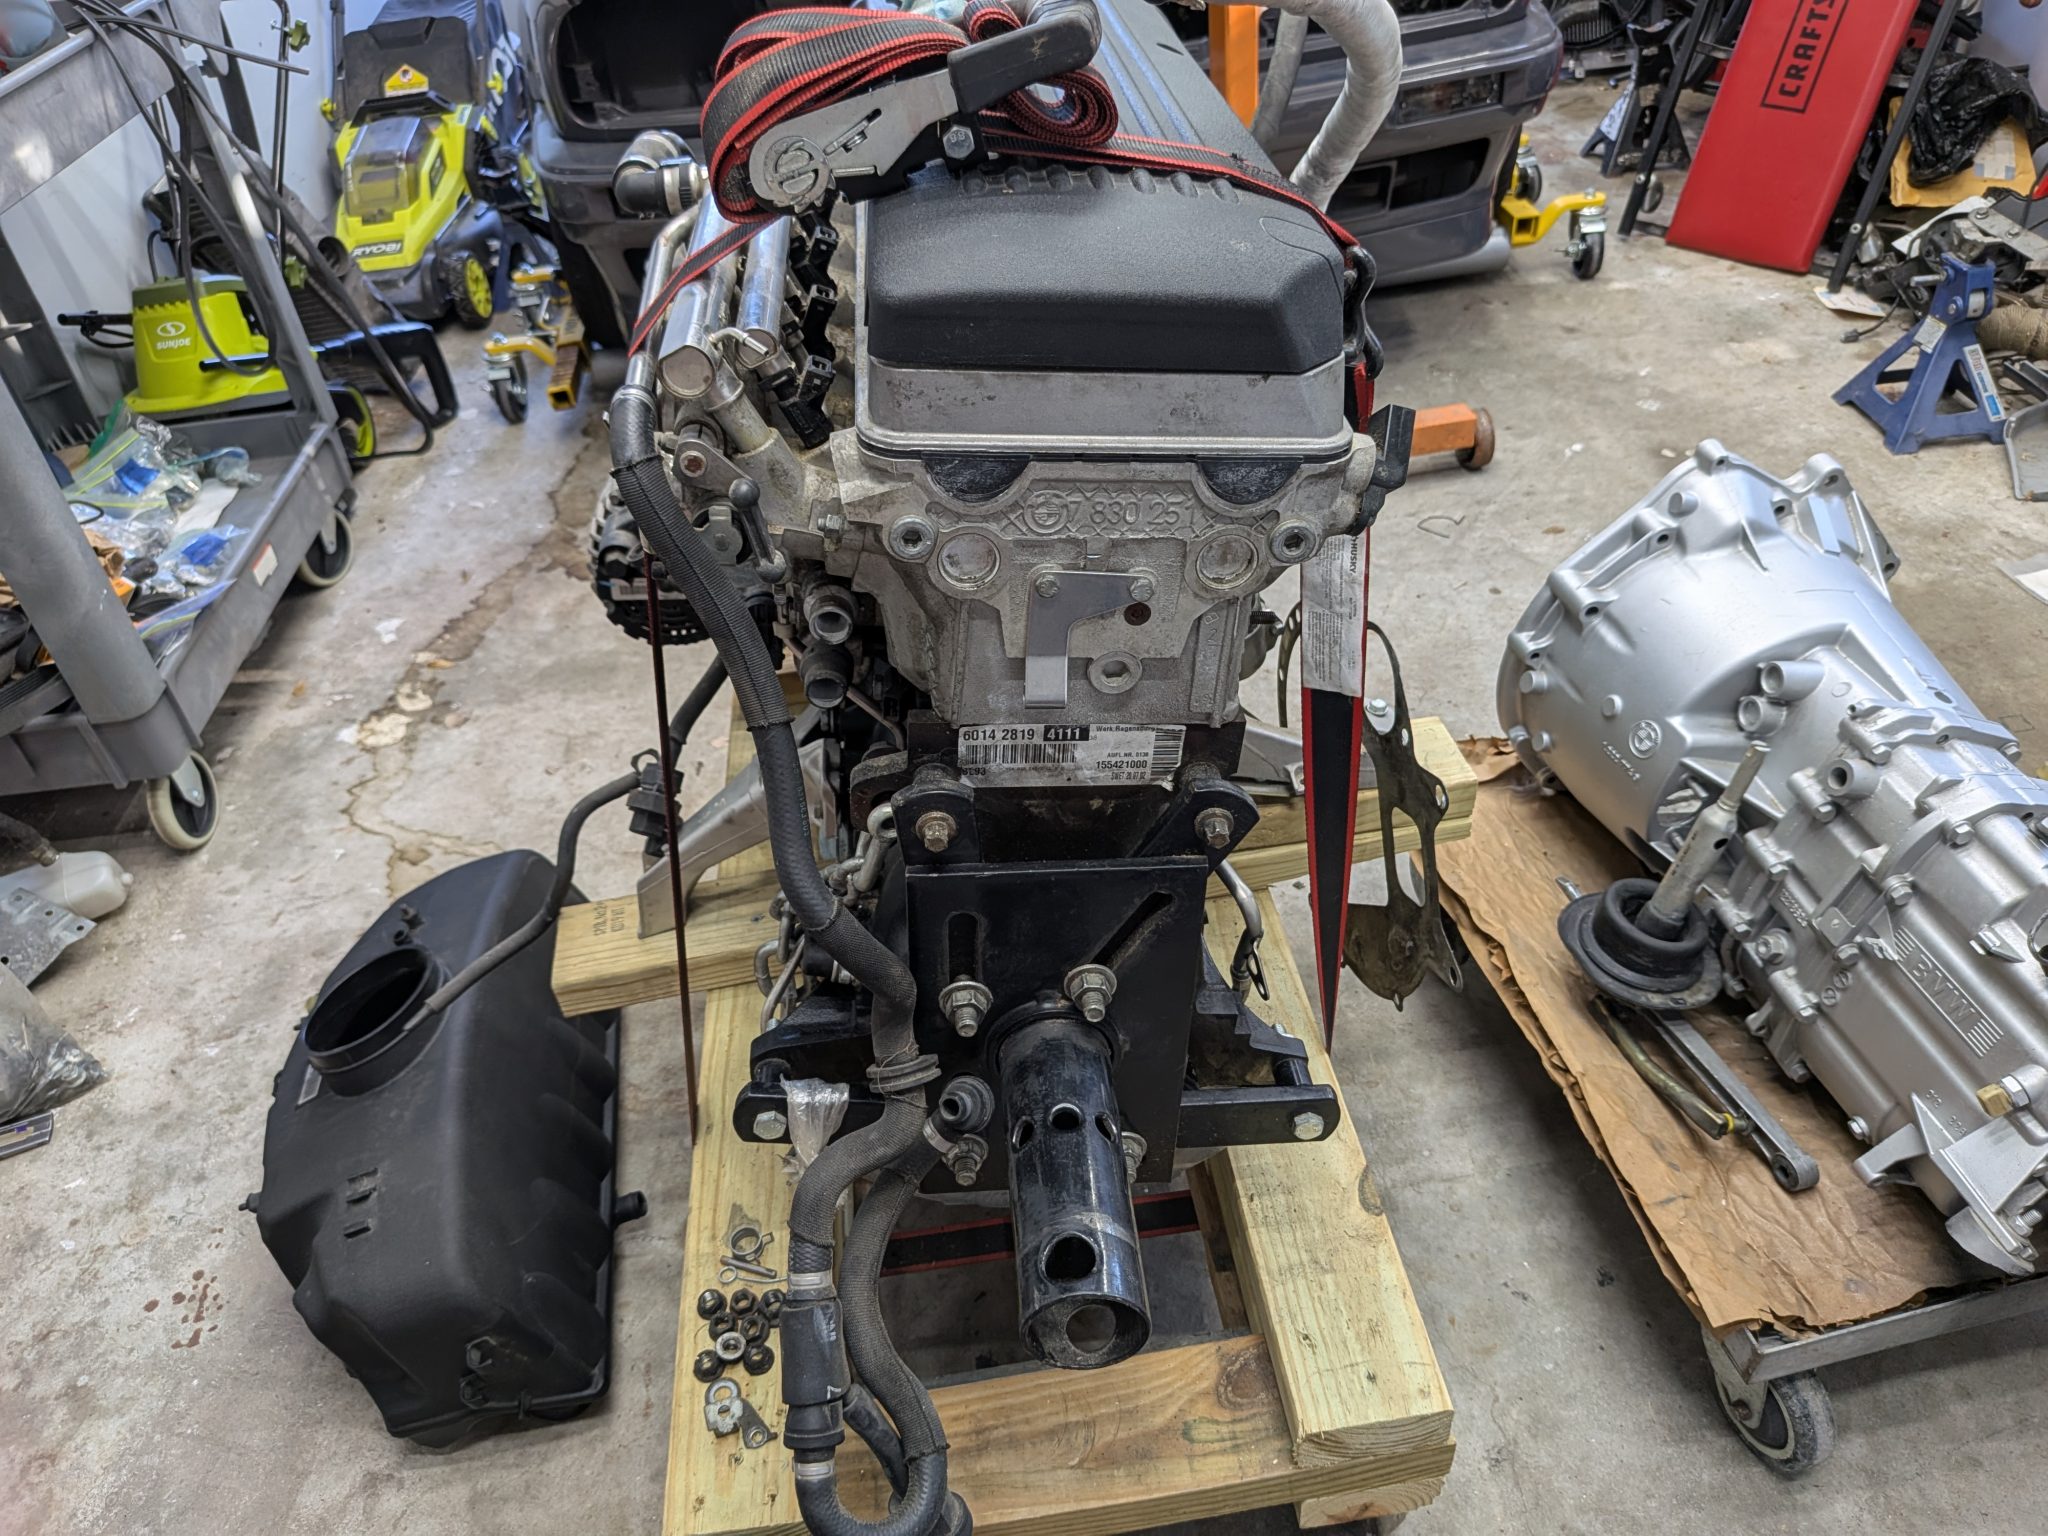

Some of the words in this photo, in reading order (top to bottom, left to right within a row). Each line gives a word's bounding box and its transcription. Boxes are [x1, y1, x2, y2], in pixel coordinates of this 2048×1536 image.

[351, 242, 402, 257] RYOBI
[1090, 501, 1140, 525] 830
[1350, 542, 1358, 574] HUSKY
[963, 729, 996, 741] 6014
[1001, 728, 1035, 741] 2819
[1047, 727, 1081, 740] 4111
[1096, 760, 1148, 770] 155421000
[1908, 953, 1976, 1022] BMW
